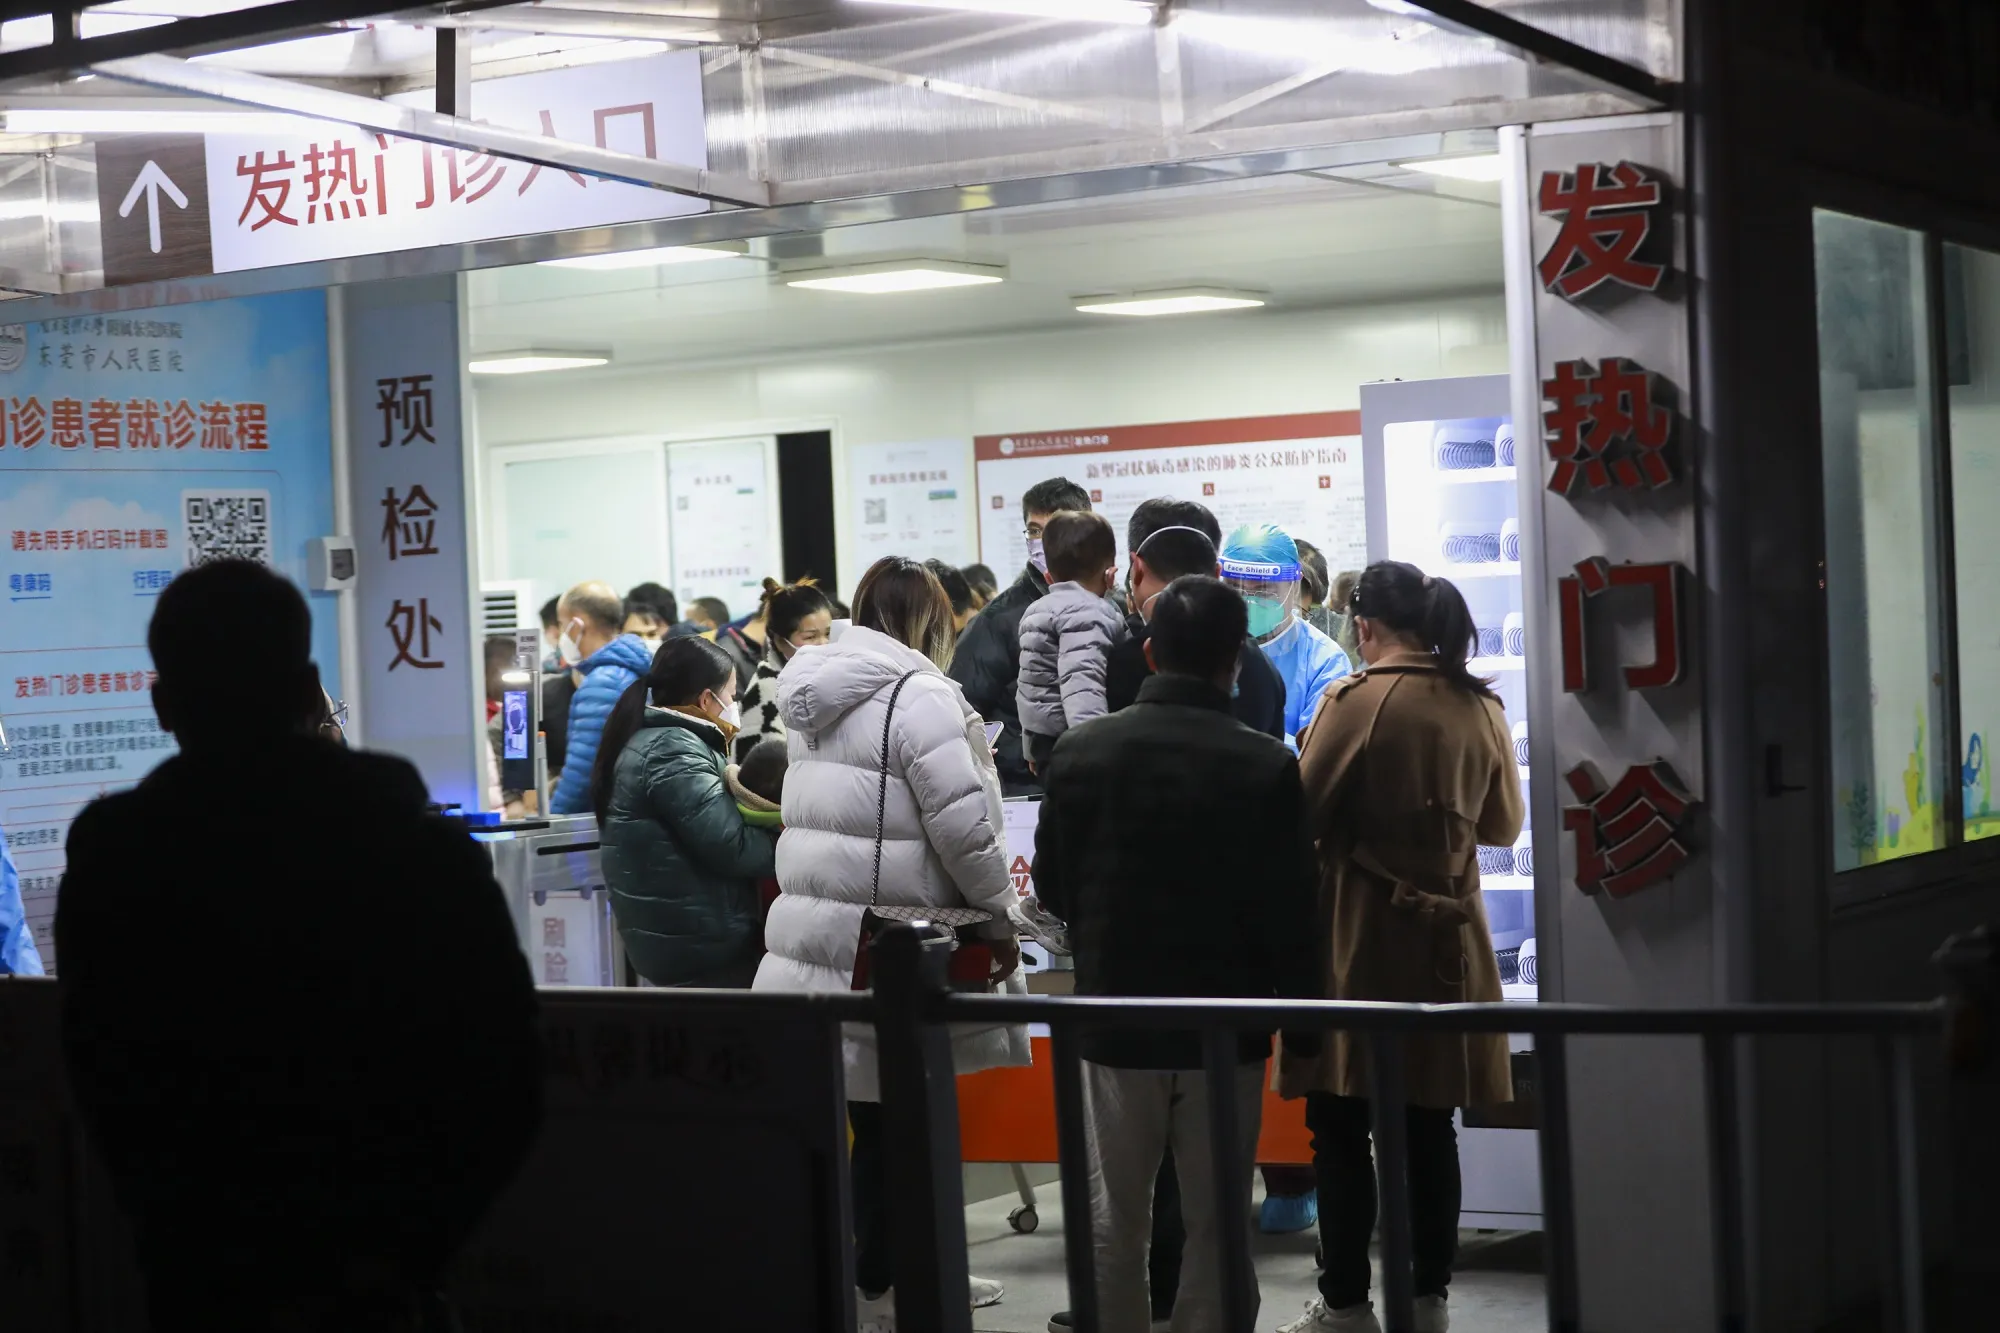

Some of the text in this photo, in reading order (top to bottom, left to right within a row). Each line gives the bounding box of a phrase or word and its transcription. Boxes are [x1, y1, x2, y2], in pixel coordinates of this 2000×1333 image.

[236, 102, 656, 232] 发热门诊入口
[37, 342, 185, 373] 东莞市人民医院
[0, 396, 270, 451] 诊患者就诊流程
[1085, 448, 1347, 479] 新型冠状病毒感染的肺炎公众防护指南
[376, 374, 445, 672] 预检处
[1537, 160, 1688, 900] 发热门诊
[11, 528, 169, 552] 请先用手机扫码并截图
[9, 573, 52, 592] 粤康码
[1227, 564, 1244, 573] Face
[1245, 565, 1271, 575] Shield
